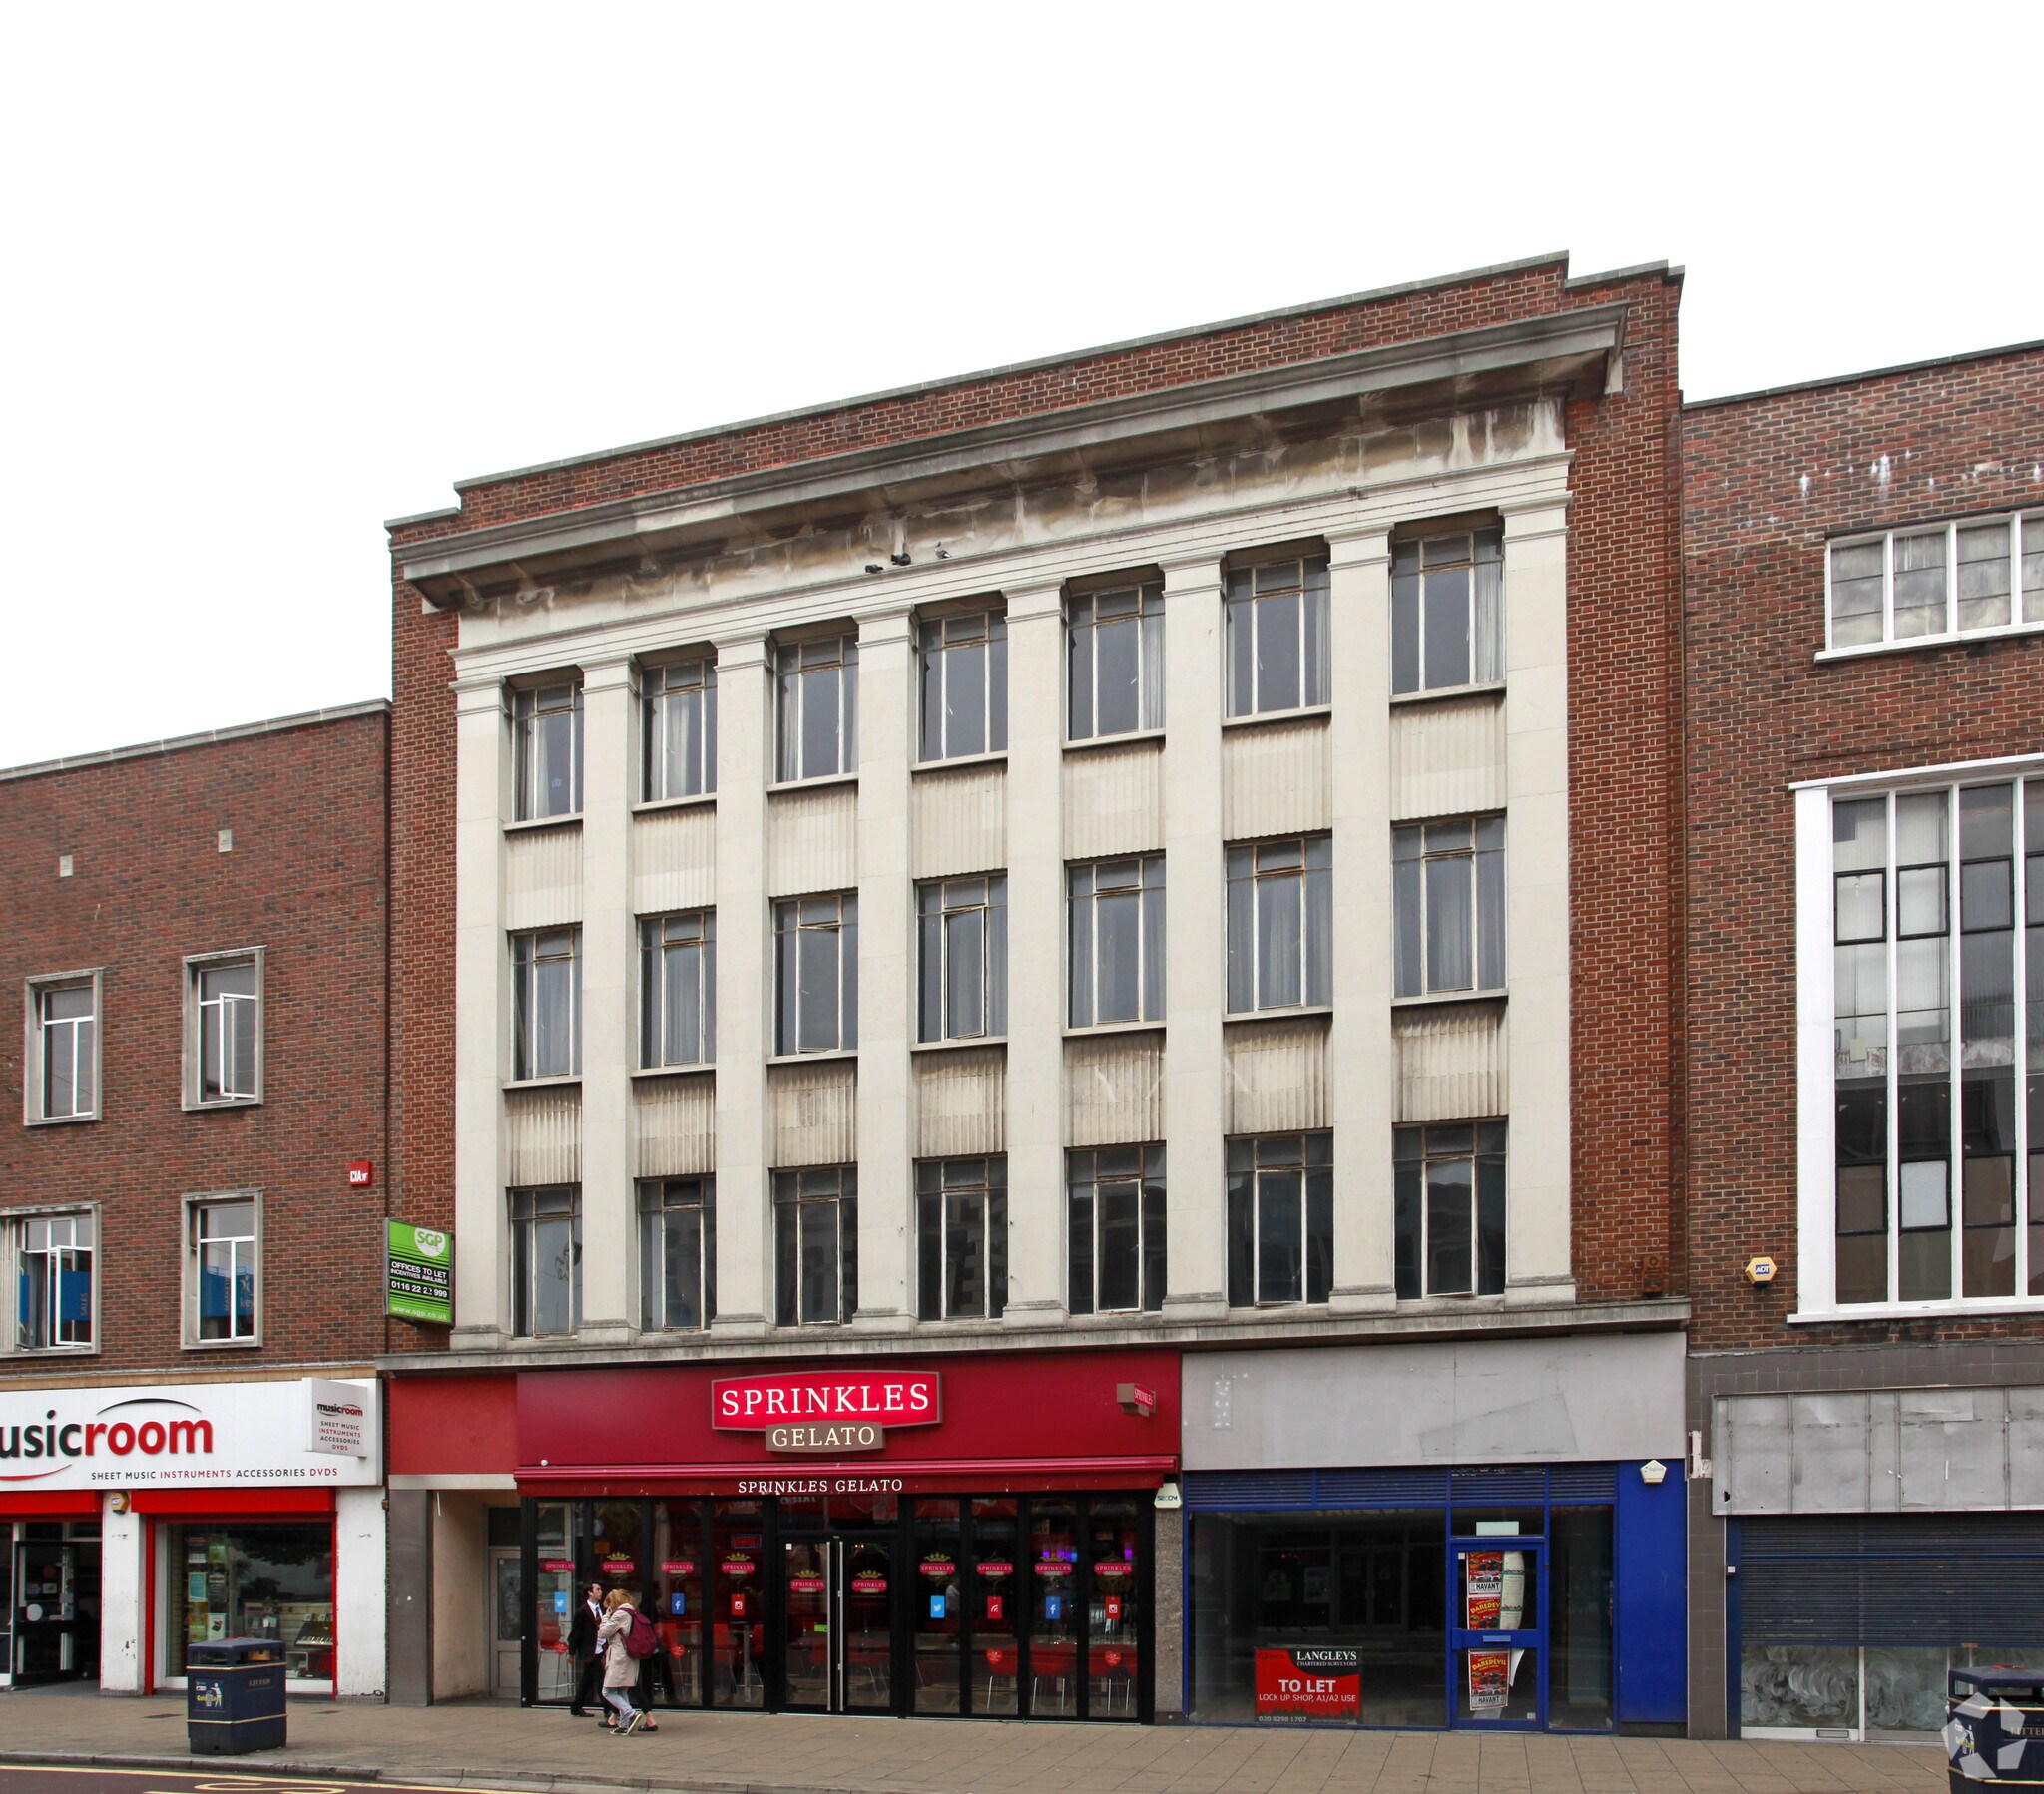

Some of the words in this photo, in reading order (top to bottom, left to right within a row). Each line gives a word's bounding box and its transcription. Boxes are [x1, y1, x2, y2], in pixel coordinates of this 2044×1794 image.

[417, 1230, 443, 1247] SGP
[391, 1261, 421, 1273] OFFICES
[422, 1267, 432, 1276] TO
[391, 1280, 410, 1291] 0116
[411, 1284, 421, 1293] 22
[434, 1289, 447, 1298] 999
[392, 1307, 447, 1320] www.sgp.co.uk
[722, 1383, 929, 1416] SPRINKLES
[317, 1403, 363, 1416] musicroom
[319, 1428, 361, 1438] INSTRUMENTS
[772, 1426, 875, 1447] GELATO
[320, 1436, 360, 1445] ACCESSORIES
[160, 1470, 232, 1479] INSTRUMENTS
[309, 1468, 338, 1477] DVDS
[738, 1480, 828, 1494] SPRINKLES
[835, 1479, 903, 1492] GELATO
[1297, 1651, 1357, 1660] LANGLEYS
[1472, 1658, 1507, 1670] DAREDEVIL
[1278, 1680, 1301, 1692] TO
[1307, 1680, 1336, 1693] LET
[1292, 1694, 1314, 1703] SHOP,
